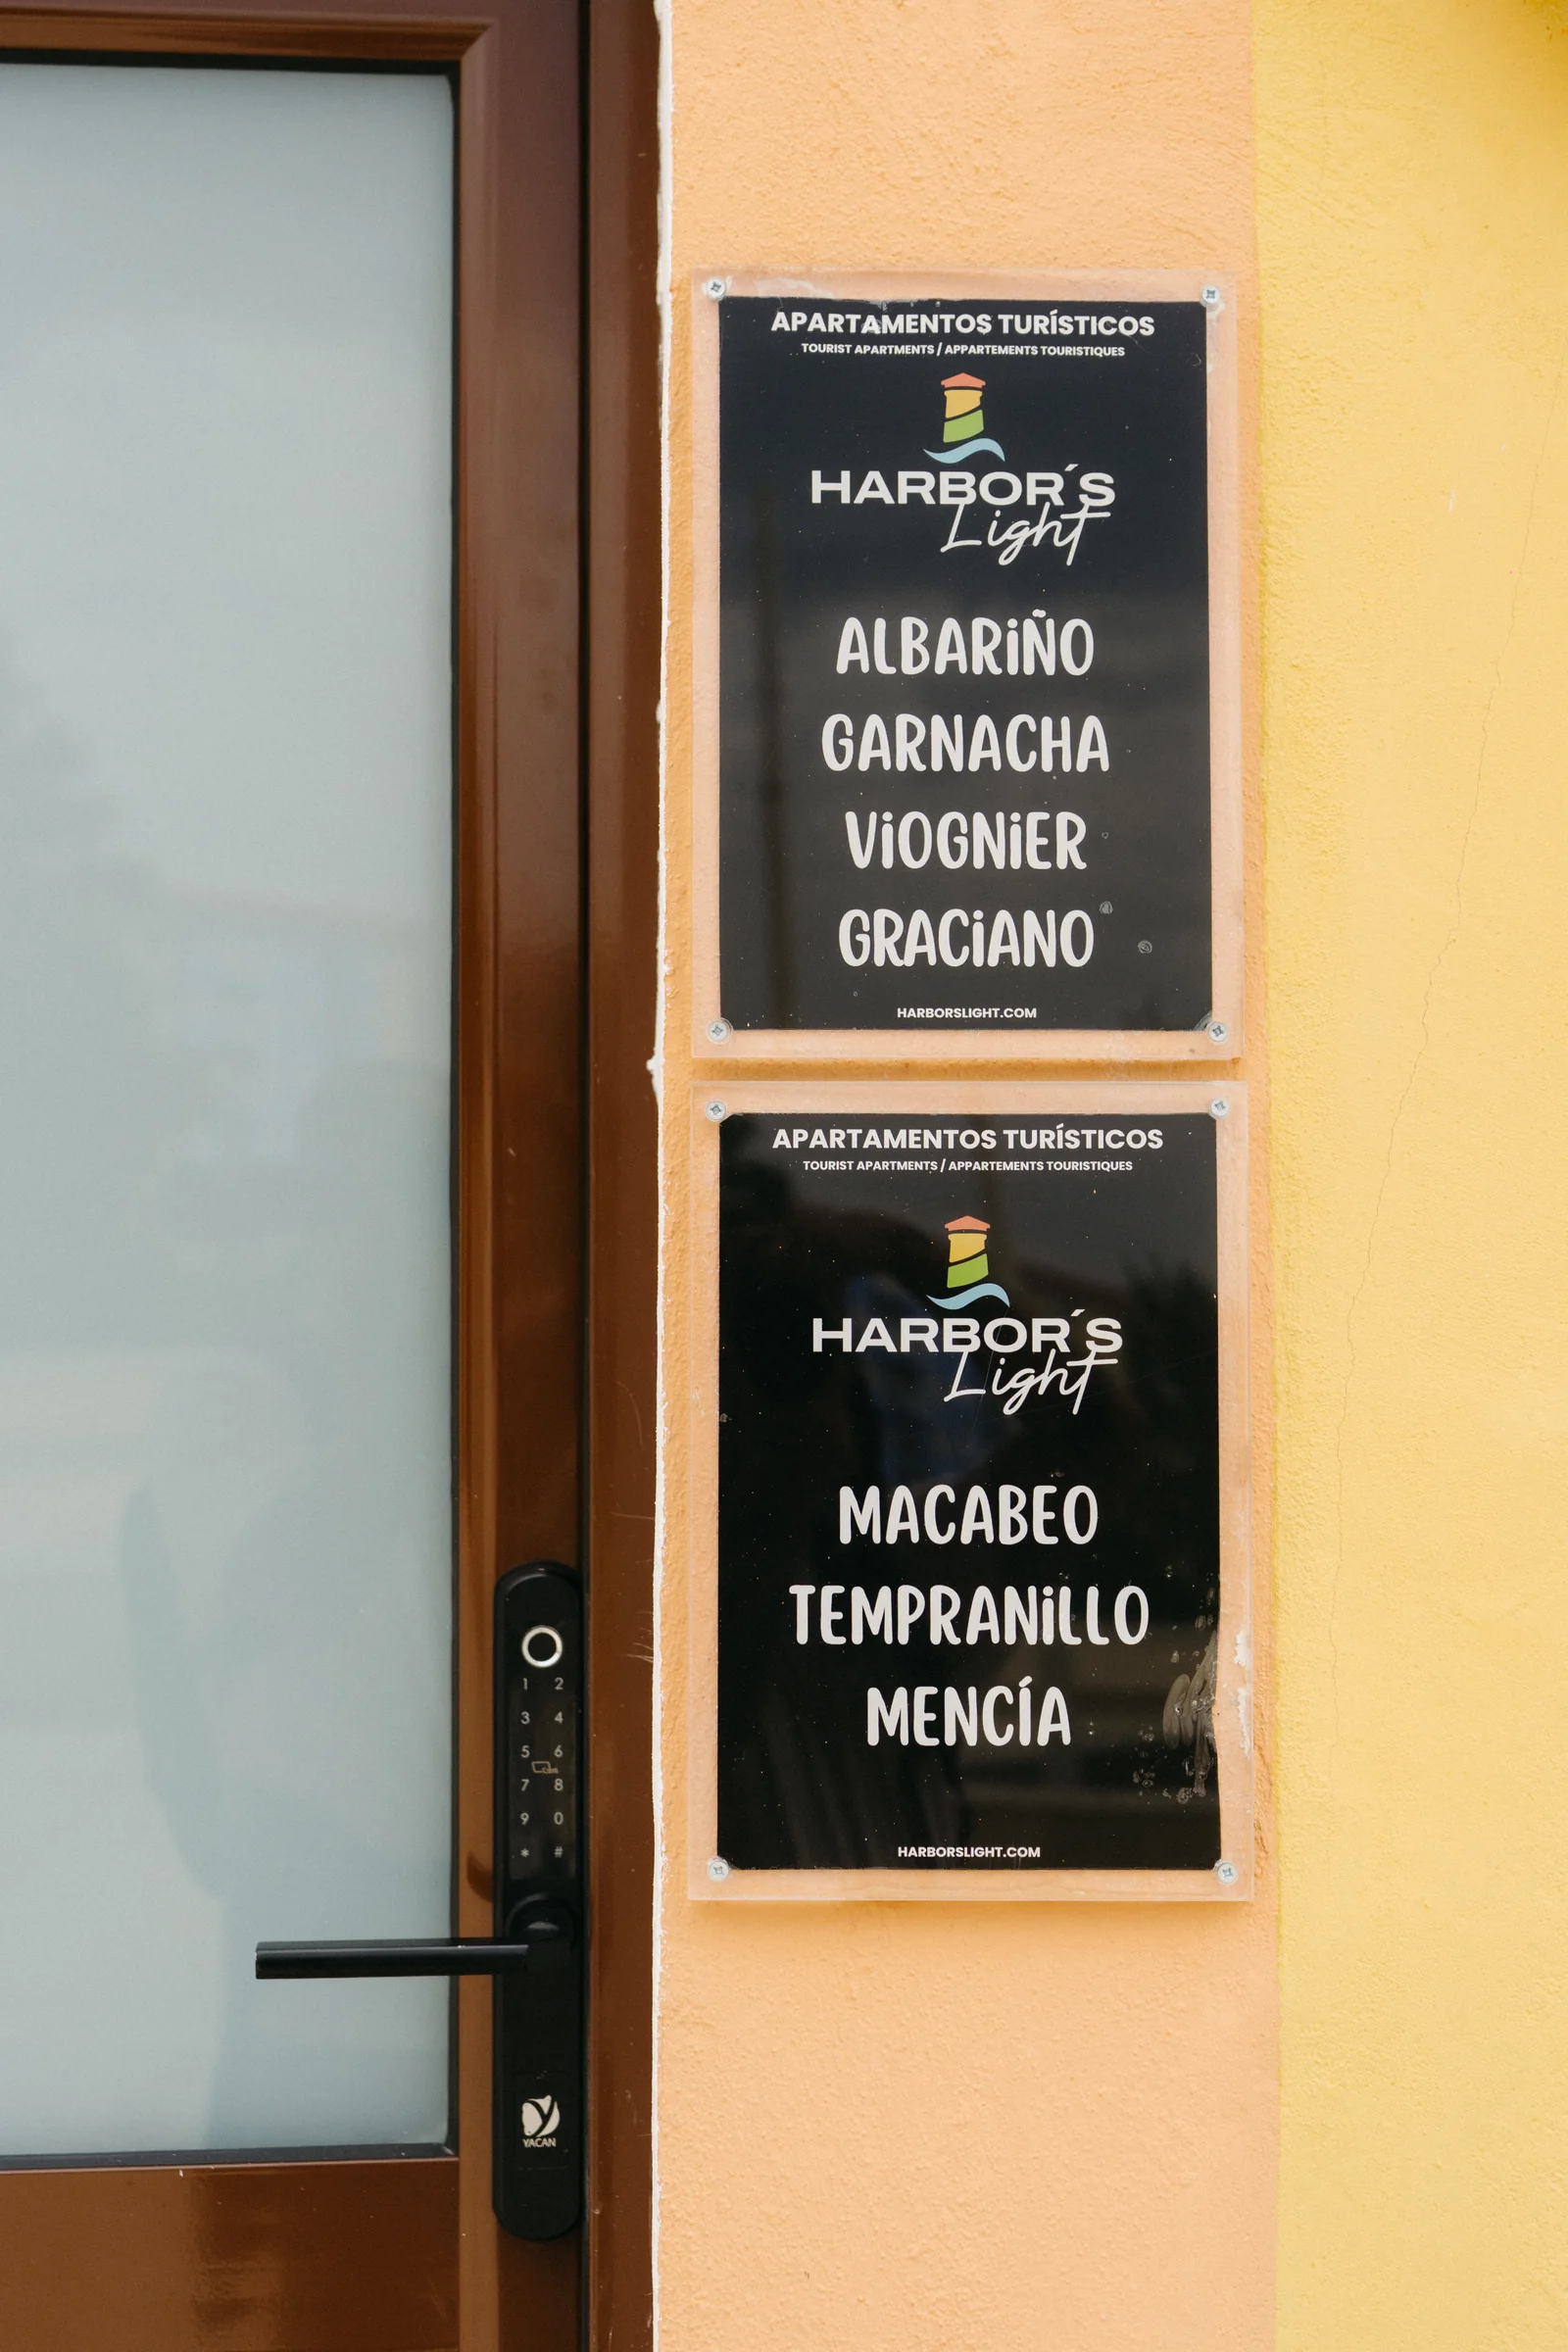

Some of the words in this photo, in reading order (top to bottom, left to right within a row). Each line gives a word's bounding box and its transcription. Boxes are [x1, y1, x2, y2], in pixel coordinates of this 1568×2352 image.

[769, 311, 993, 335] APARTAMENTOS
[997, 309, 1155, 337] TURÍSTICOS
[801, 342, 853, 354] TOURIST
[854, 344, 935, 355] APARTMENTS
[936, 341, 943, 357] /
[944, 344, 1039, 356] APPARTEMENTS
[1040, 345, 1126, 358] TOURISTIQUES
[939, 501, 1111, 566] Light
[821, 712, 1110, 773] GARNACHA
[897, 1007, 1037, 1019] HARBORSLIGHT.COM
[771, 1128, 998, 1150] APARTAMENTOS
[1003, 1122, 1164, 1150] TURÍSTICOS
[803, 1160, 855, 1171] TOURIST
[856, 1160, 939, 1171] APARTMENTS
[940, 1157, 947, 1173] /
[948, 1160, 1045, 1171] APPARTEMENTS
[1046, 1160, 1133, 1173] TOURISTIQUES
[943, 1348, 1118, 1415] Light
[839, 1484, 1099, 1545] MACABEO
[522, 1677, 528, 1690] 1
[555, 1677, 564, 1690] 2
[520, 1711, 530, 1725] 3
[554, 1711, 564, 1724] 4
[866, 1675, 1071, 1747] MENCÍA
[520, 1744, 530, 1758] 5
[554, 1744, 564, 1758] 6
[521, 1779, 530, 1791] 7
[554, 1778, 564, 1791] 8
[520, 1812, 529, 1825] 9
[554, 1811, 564, 1826] 0
[898, 1846, 1041, 1858] HARBORSLIGHT.COM
[522, 2137, 557, 2148] YACAN
